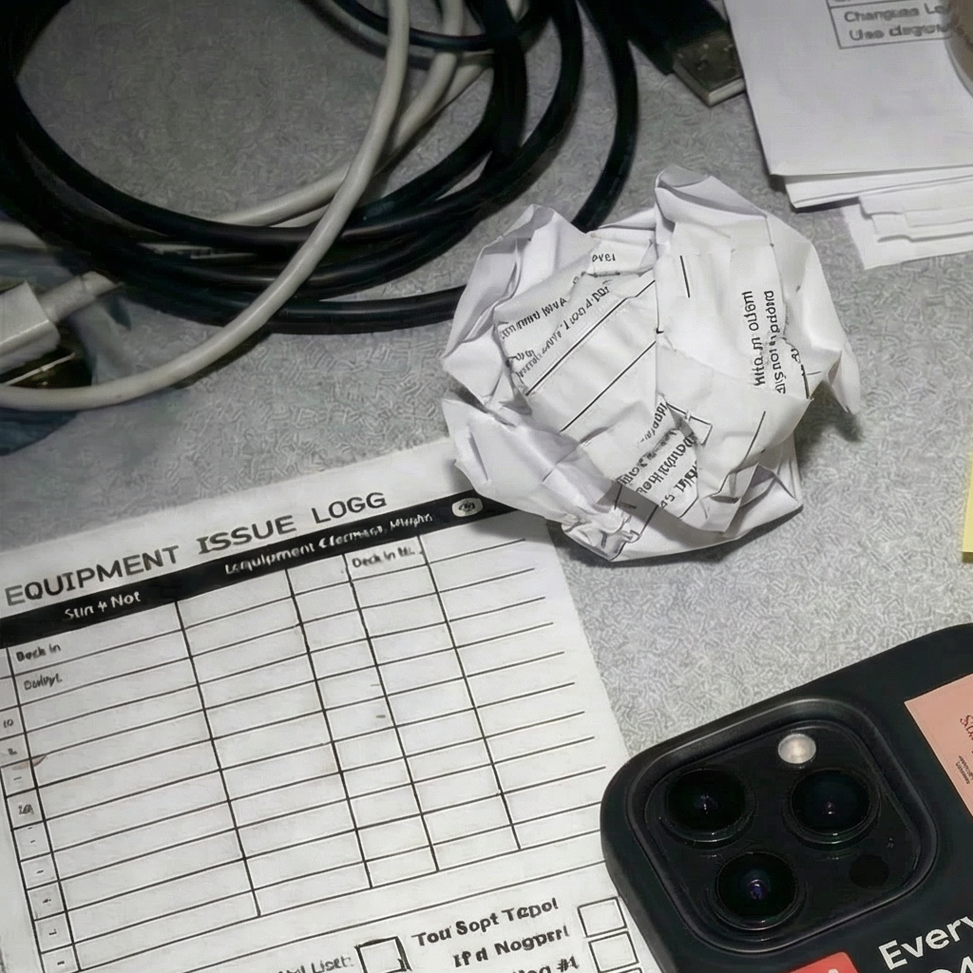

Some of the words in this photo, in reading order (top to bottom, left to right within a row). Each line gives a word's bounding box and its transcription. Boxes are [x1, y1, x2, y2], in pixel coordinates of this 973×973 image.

[5, 545, 179, 606] EQUIPMENT
[197, 515, 297, 555] ISSUE
[312, 491, 386, 524] LOGG
[455, 912, 499, 936] Sopt
